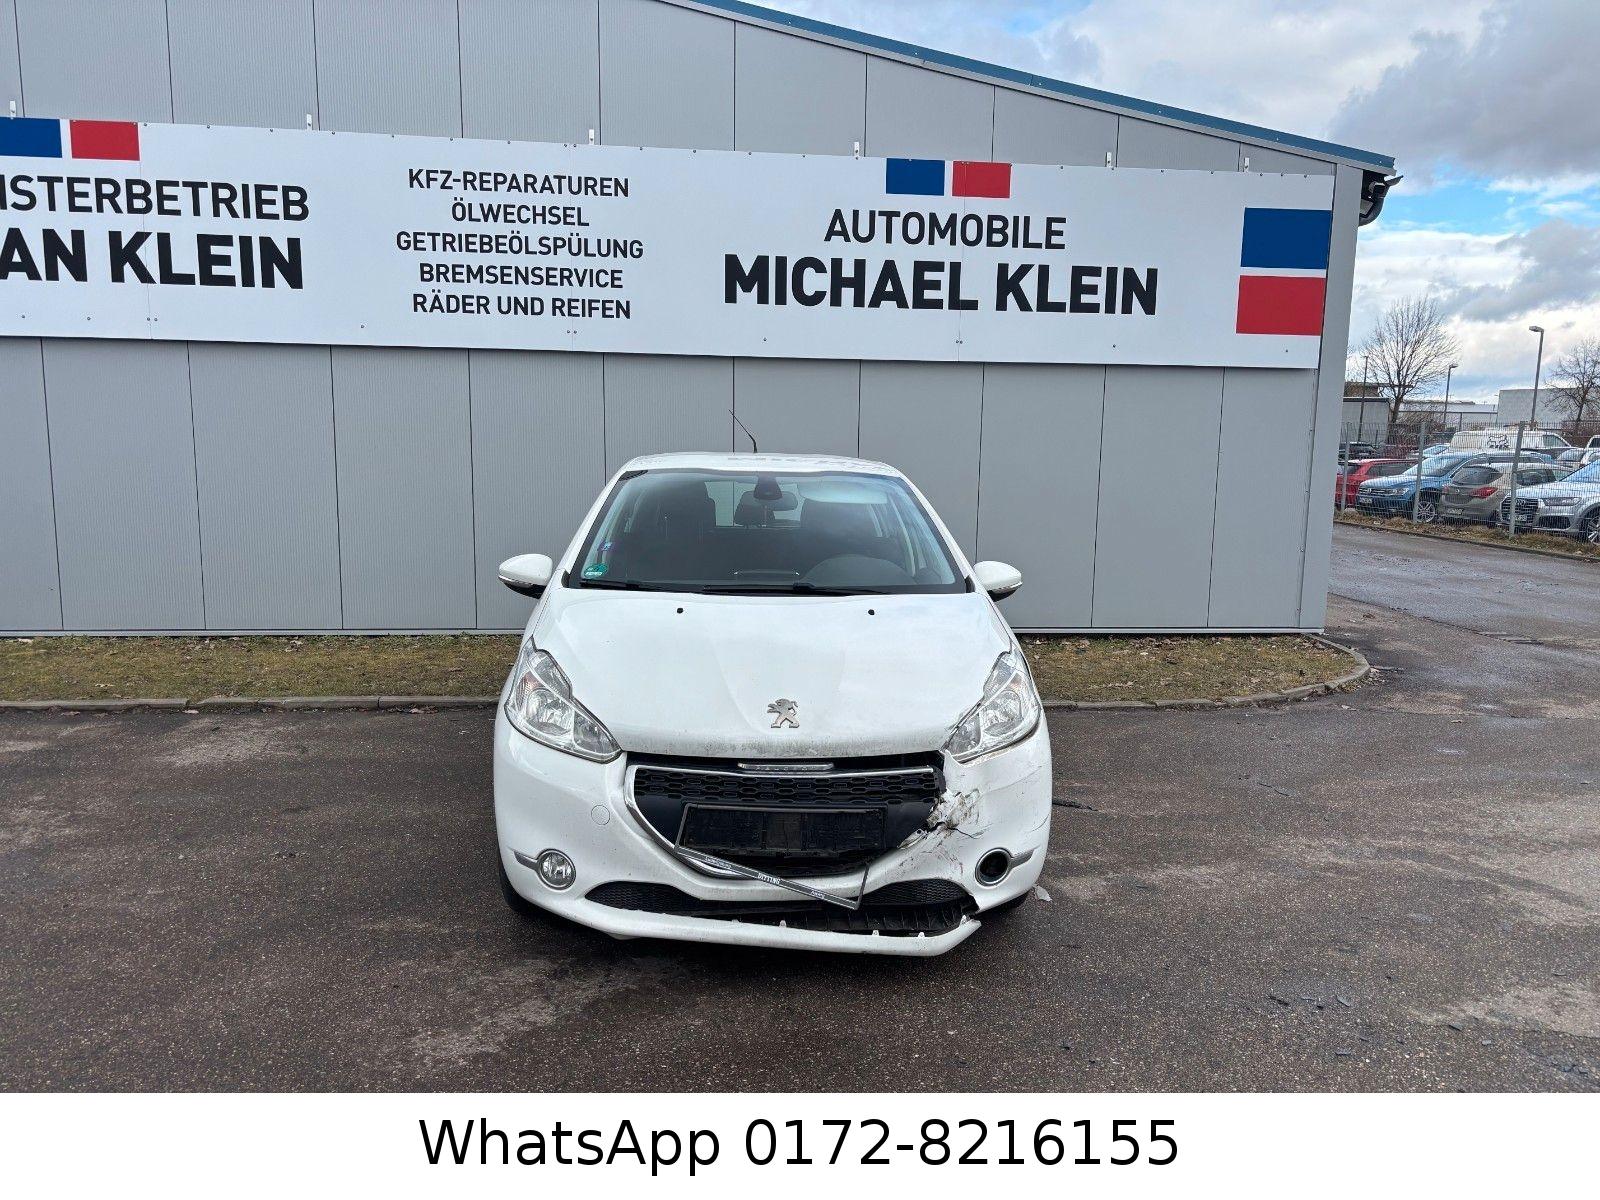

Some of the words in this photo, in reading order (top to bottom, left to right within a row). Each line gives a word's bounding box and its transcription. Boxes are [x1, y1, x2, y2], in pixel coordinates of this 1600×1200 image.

[408, 168, 629, 198] KFZ-REPARATUREN
[451, 197, 590, 227] ÖLWECHSEL
[823, 208, 1067, 250] AUTOMOBILE
[0, 227, 88, 283] AN
[108, 230, 304, 290] KLEIN
[396, 230, 644, 259] GETRIEBEÖLSPÜLUNG
[419, 262, 624, 289] BREMSENSERVICE
[724, 253, 979, 311] MICHAEL
[995, 262, 1159, 316] KLEIN
[412, 289, 491, 315] RÄDER
[497, 295, 545, 316] UND
[551, 297, 631, 320] REIFEN
